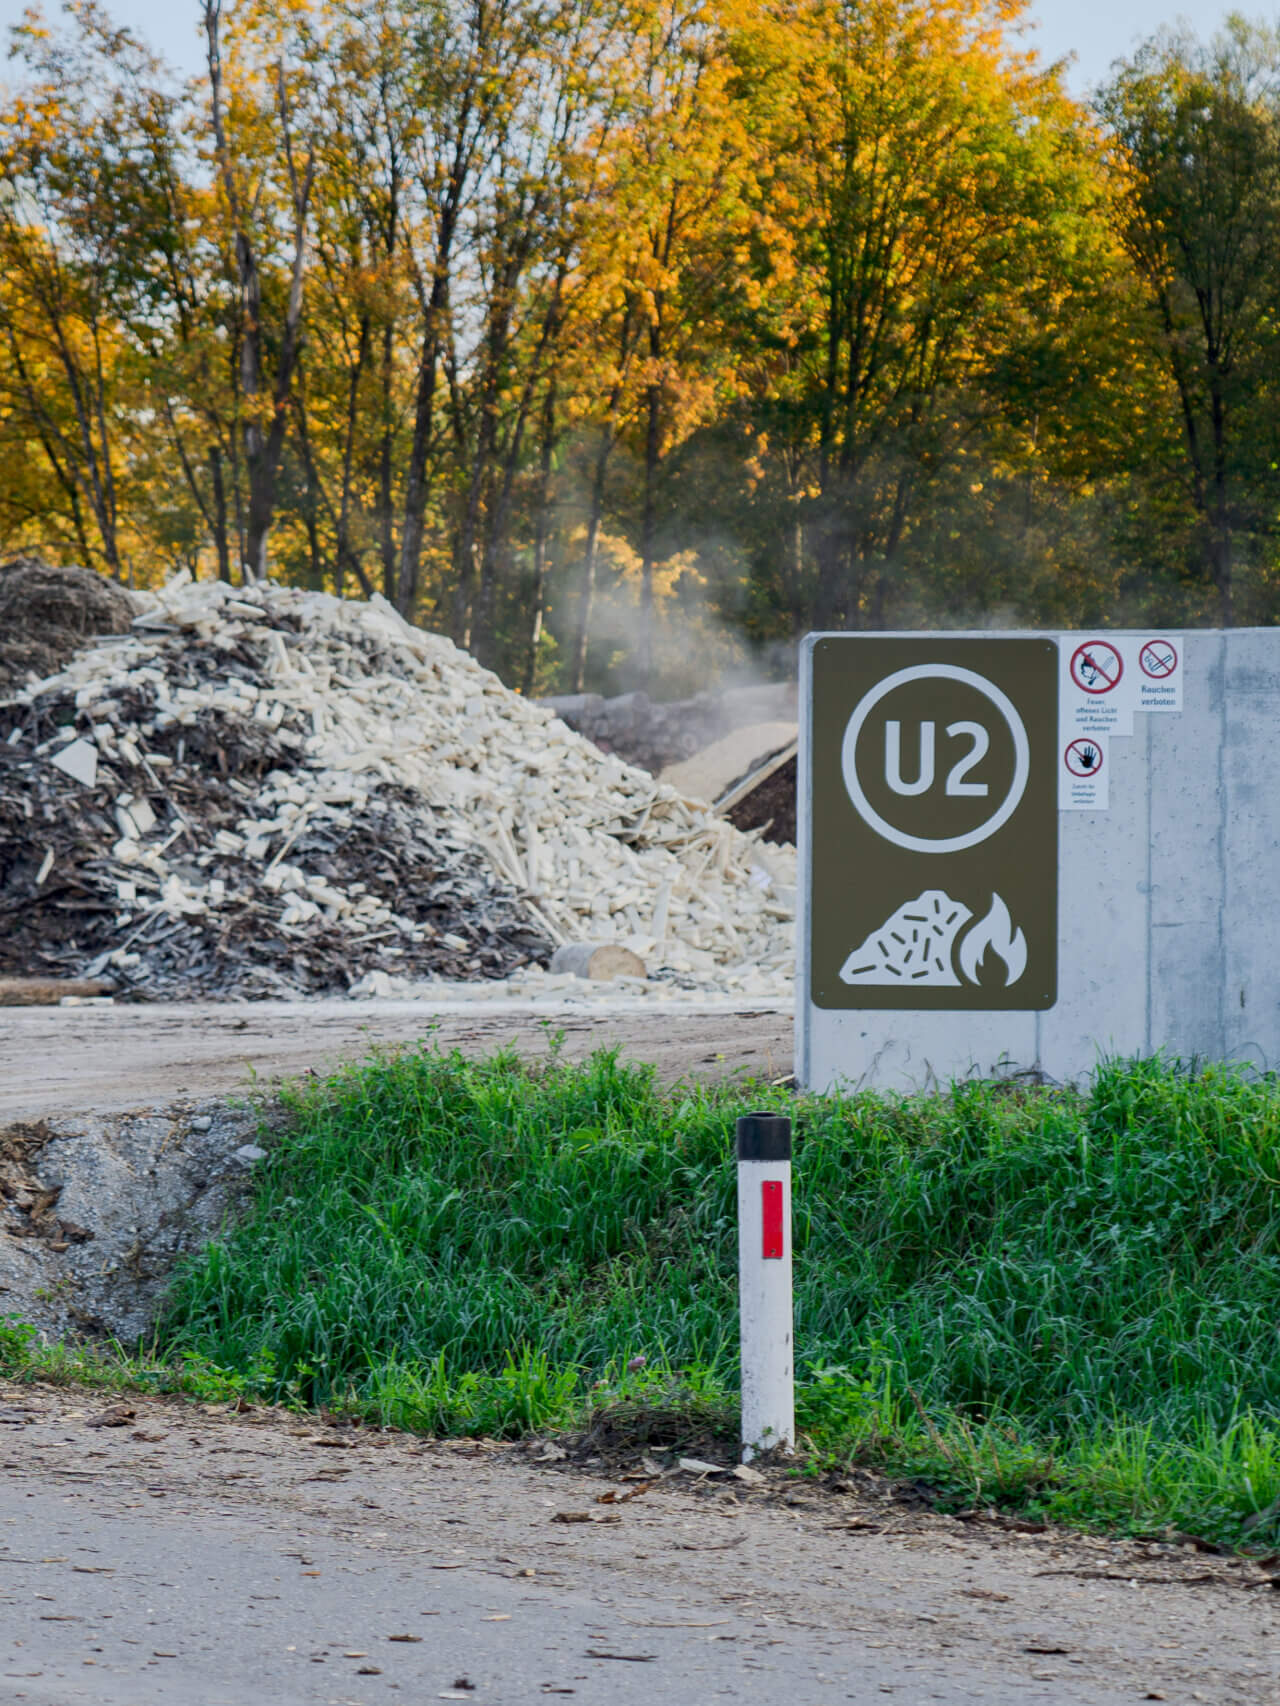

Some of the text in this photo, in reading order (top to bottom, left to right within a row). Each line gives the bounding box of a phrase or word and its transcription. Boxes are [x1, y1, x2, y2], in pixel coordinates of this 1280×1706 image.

[1141, 685, 1176, 694] Rauchen
[1141, 698, 1176, 706] verboten
[885, 720, 990, 796] U2
